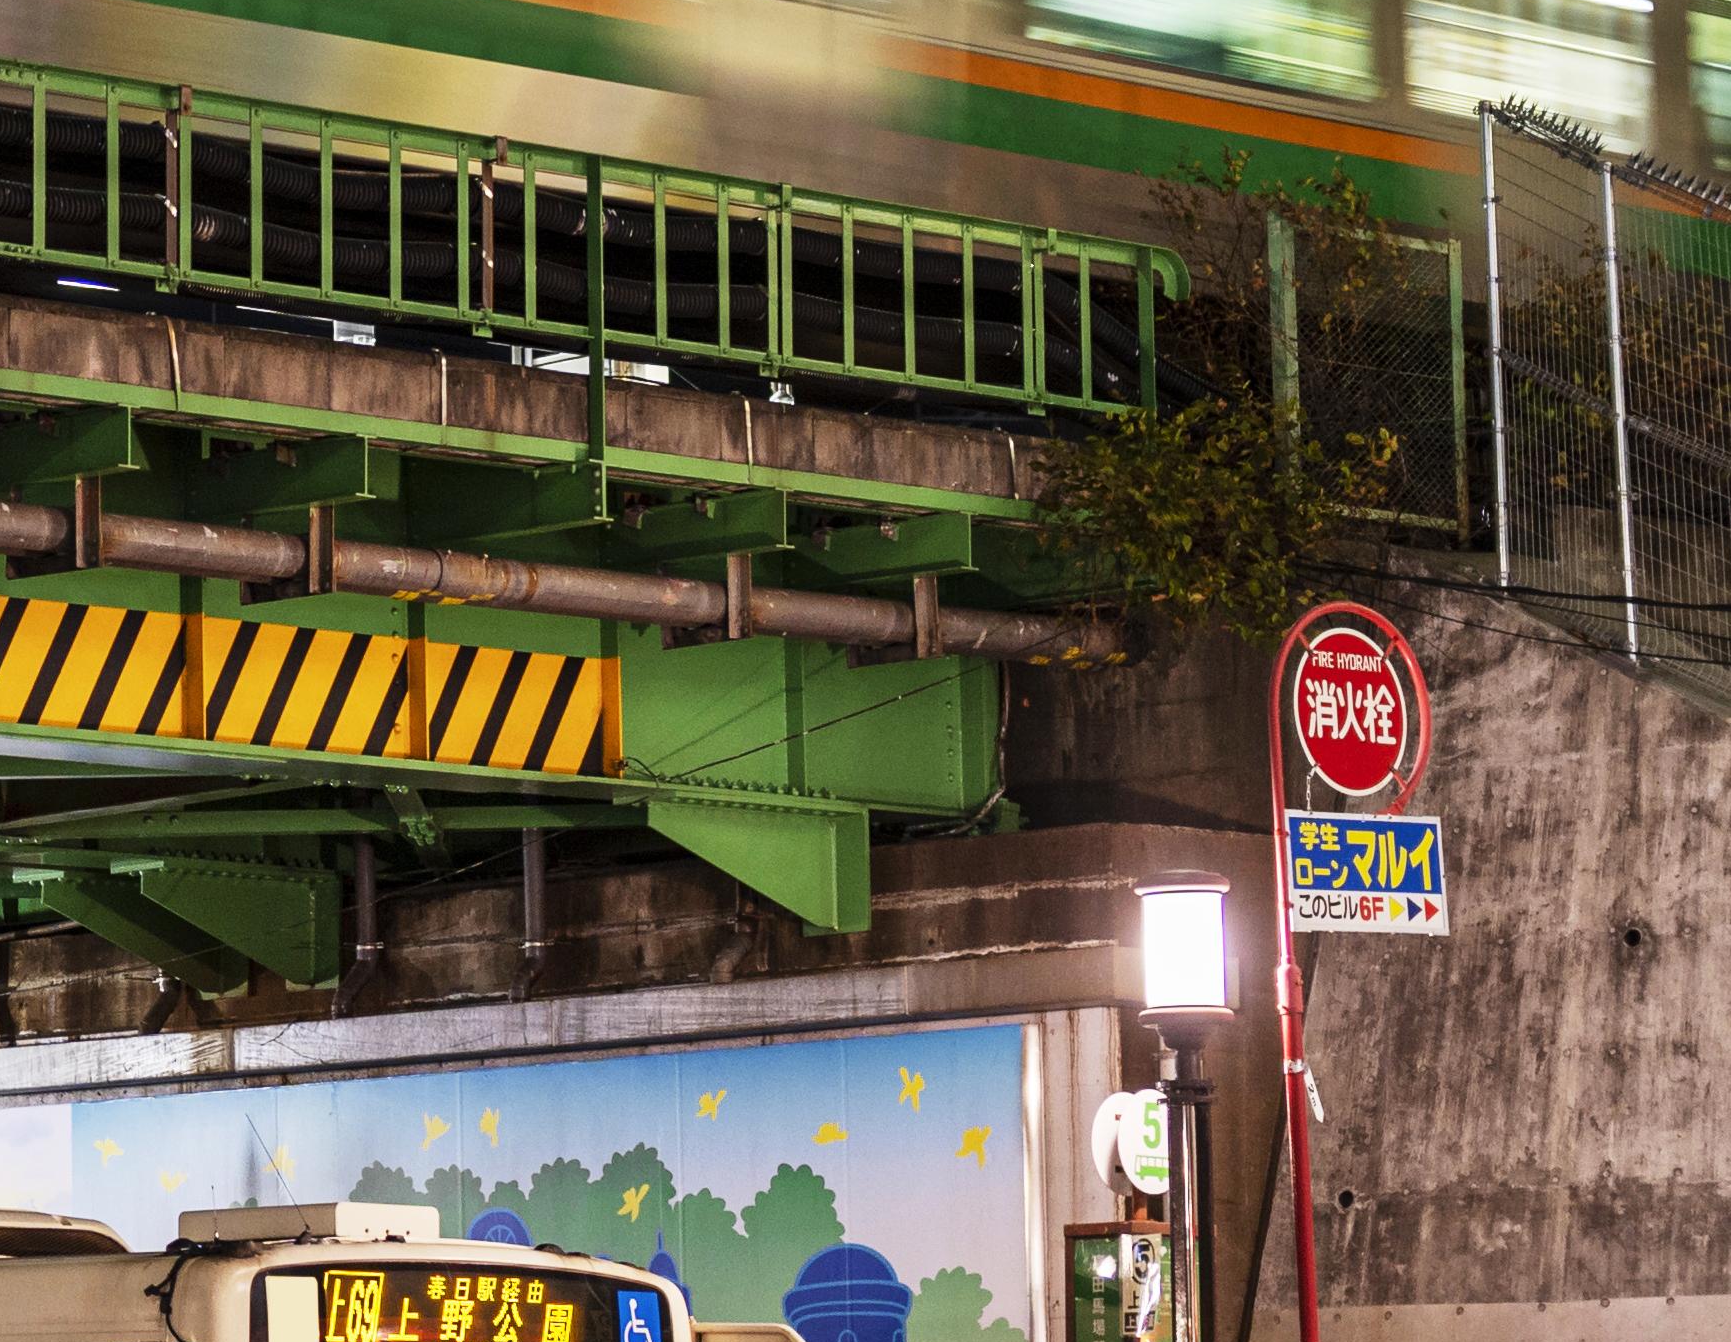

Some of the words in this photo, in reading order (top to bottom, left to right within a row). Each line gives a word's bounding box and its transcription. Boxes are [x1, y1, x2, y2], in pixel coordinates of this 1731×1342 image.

[1312, 650, 1335, 669] FIRE
[1337, 652, 1382, 673] HYDRANT
[1305, 678, 1397, 745] 消火栓
[1299, 821, 1341, 851] 学生
[1295, 858, 1349, 889] ローン
[1346, 827, 1435, 891] マルイ
[1299, 894, 1384, 921] このビル6F
[1143, 1102, 1161, 1149] 5
[426, 1276, 544, 1304] 春日駅経由
